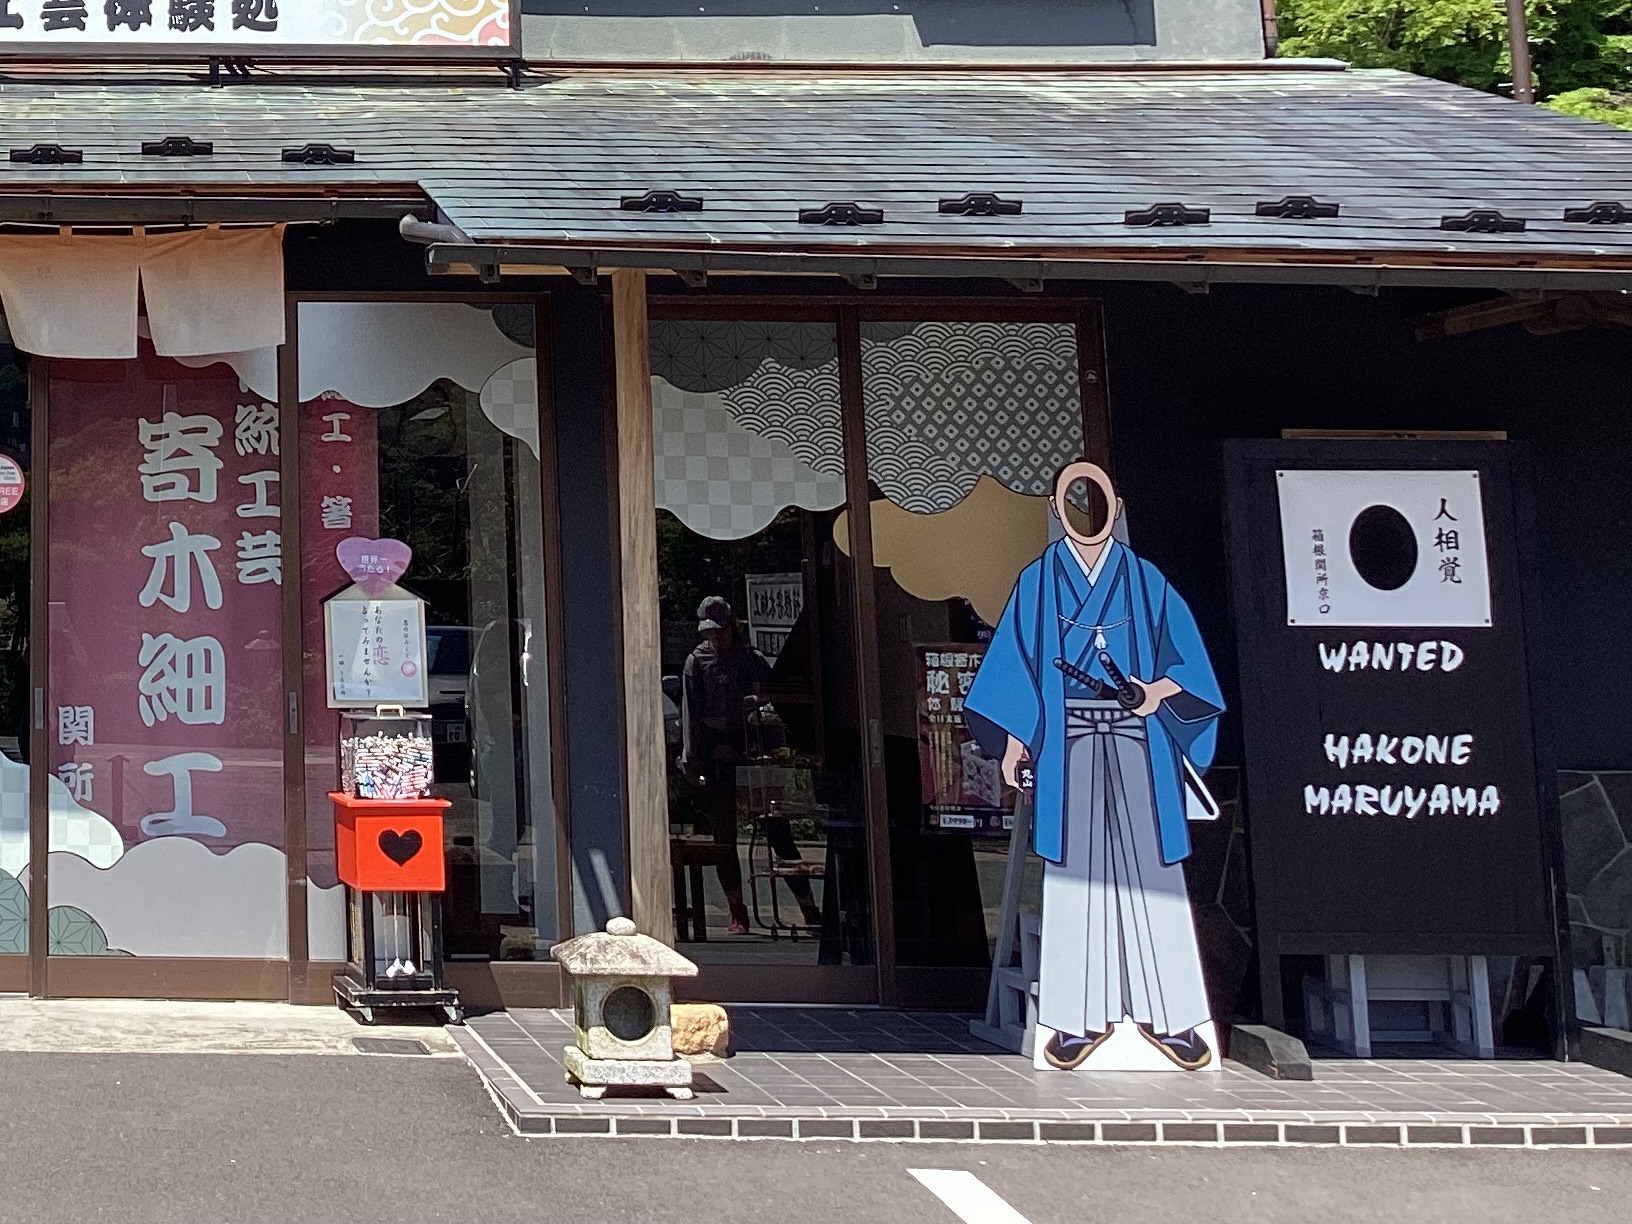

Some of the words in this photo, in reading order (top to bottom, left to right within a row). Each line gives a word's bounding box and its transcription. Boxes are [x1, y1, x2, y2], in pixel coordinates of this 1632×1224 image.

[1433, 497, 1462, 584] 人相覚
[138, 412, 228, 837] 寄木細工
[1319, 641, 1464, 673] WANTED
[1324, 733, 1473, 769] HAKONE
[1304, 784, 1500, 819] MARUYAMA
